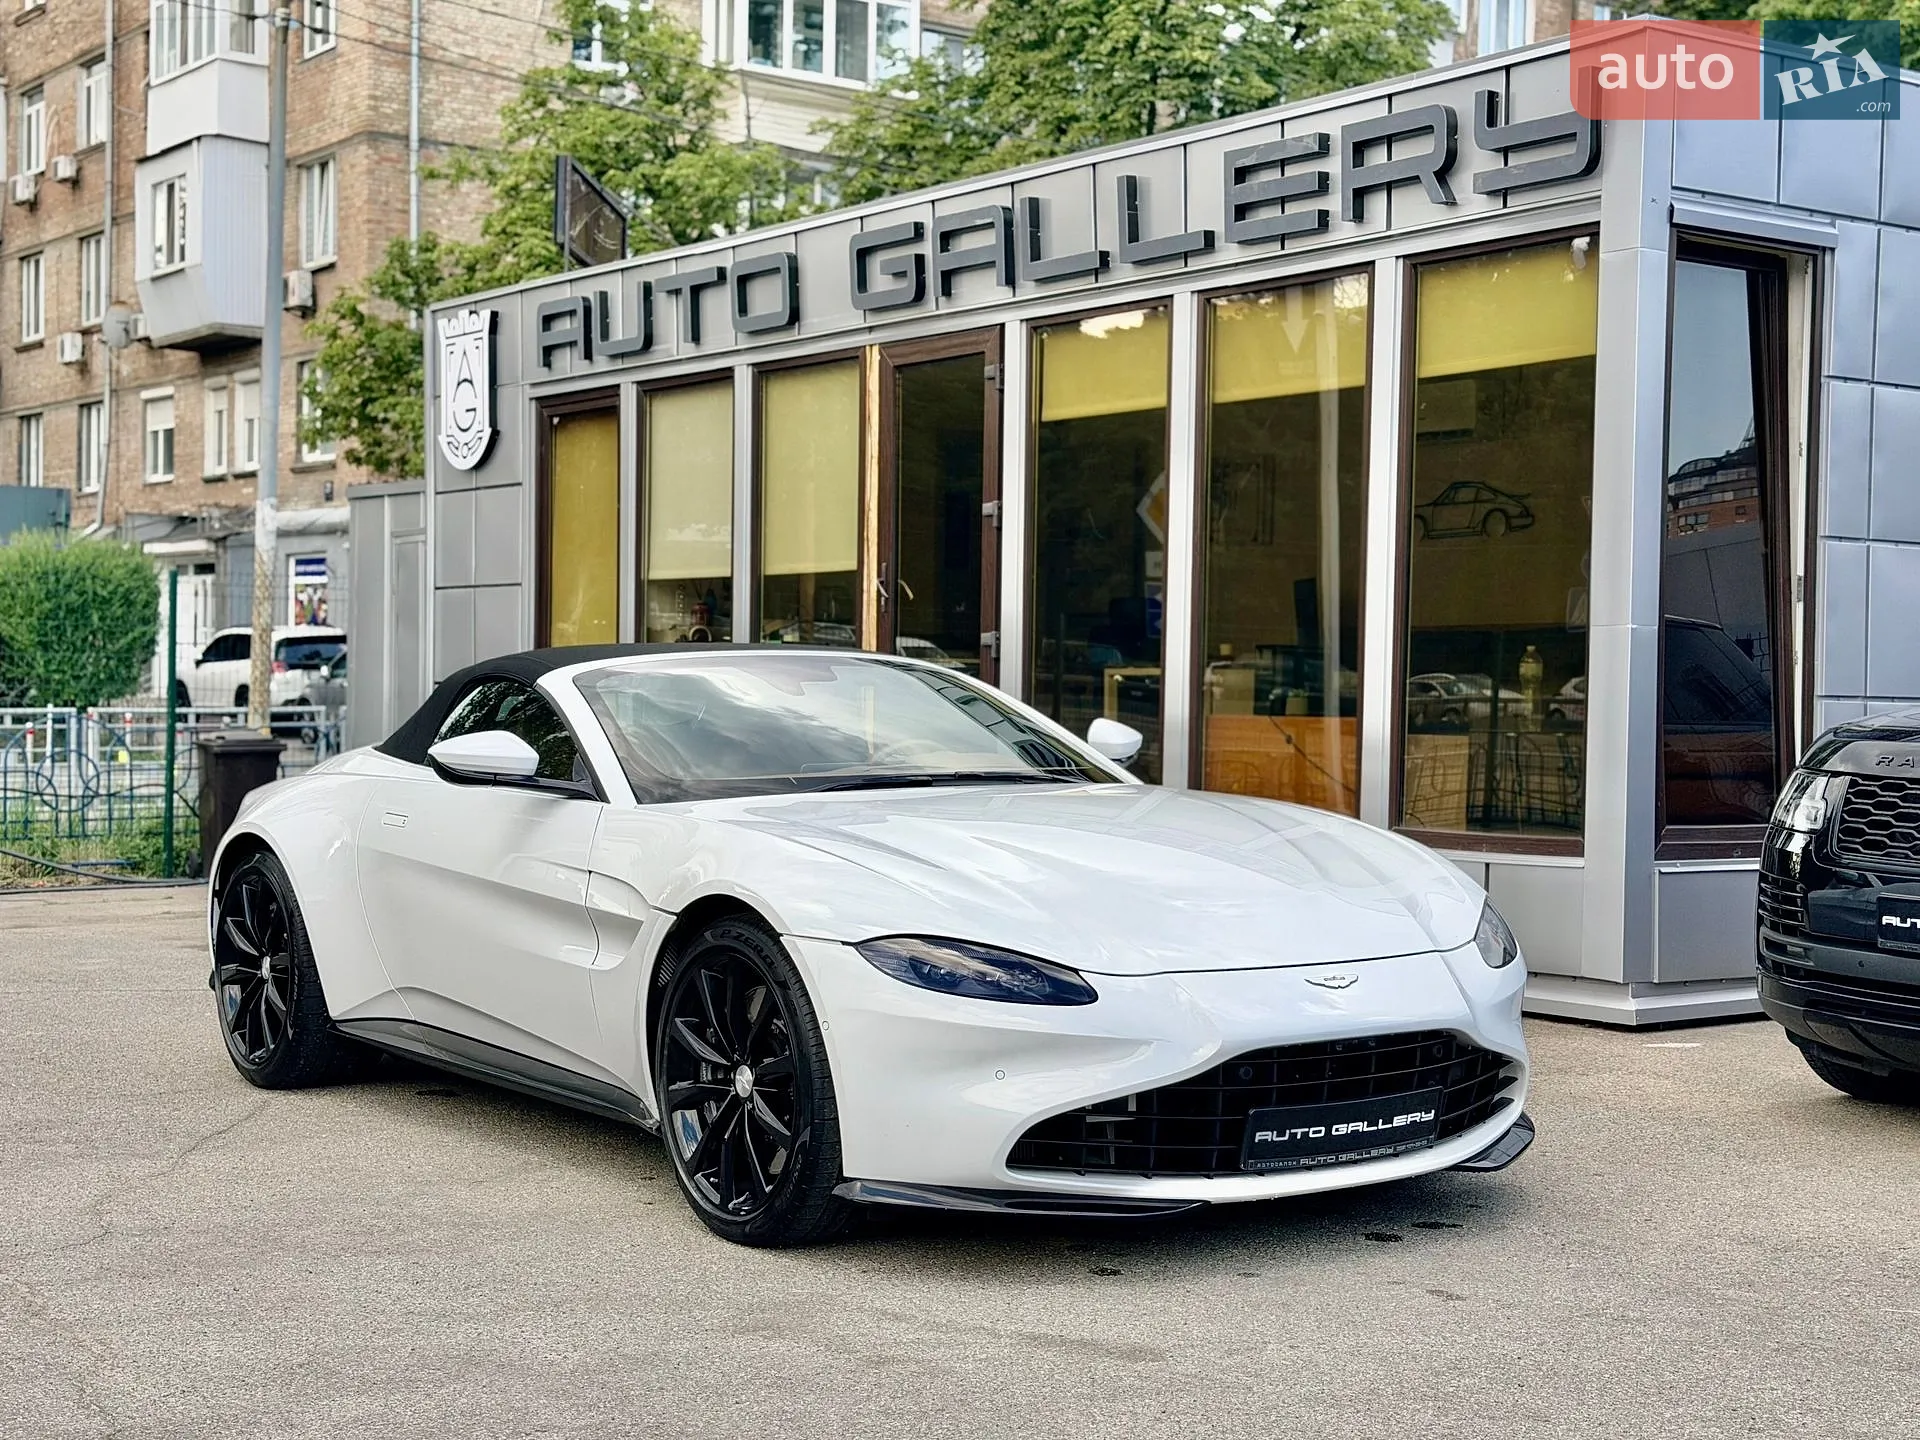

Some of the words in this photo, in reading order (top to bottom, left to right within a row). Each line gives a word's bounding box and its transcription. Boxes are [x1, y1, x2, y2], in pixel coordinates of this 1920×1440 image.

[537, 252, 800, 369] AUTO
[850, 65, 1603, 310] GALLERY
[1254, 1126, 1326, 1143] AUTO
[1331, 1109, 1435, 1135] GALLERY
[1300, 1155, 1336, 1166] AUTO
[1338, 1146, 1394, 1161] GALLERY
